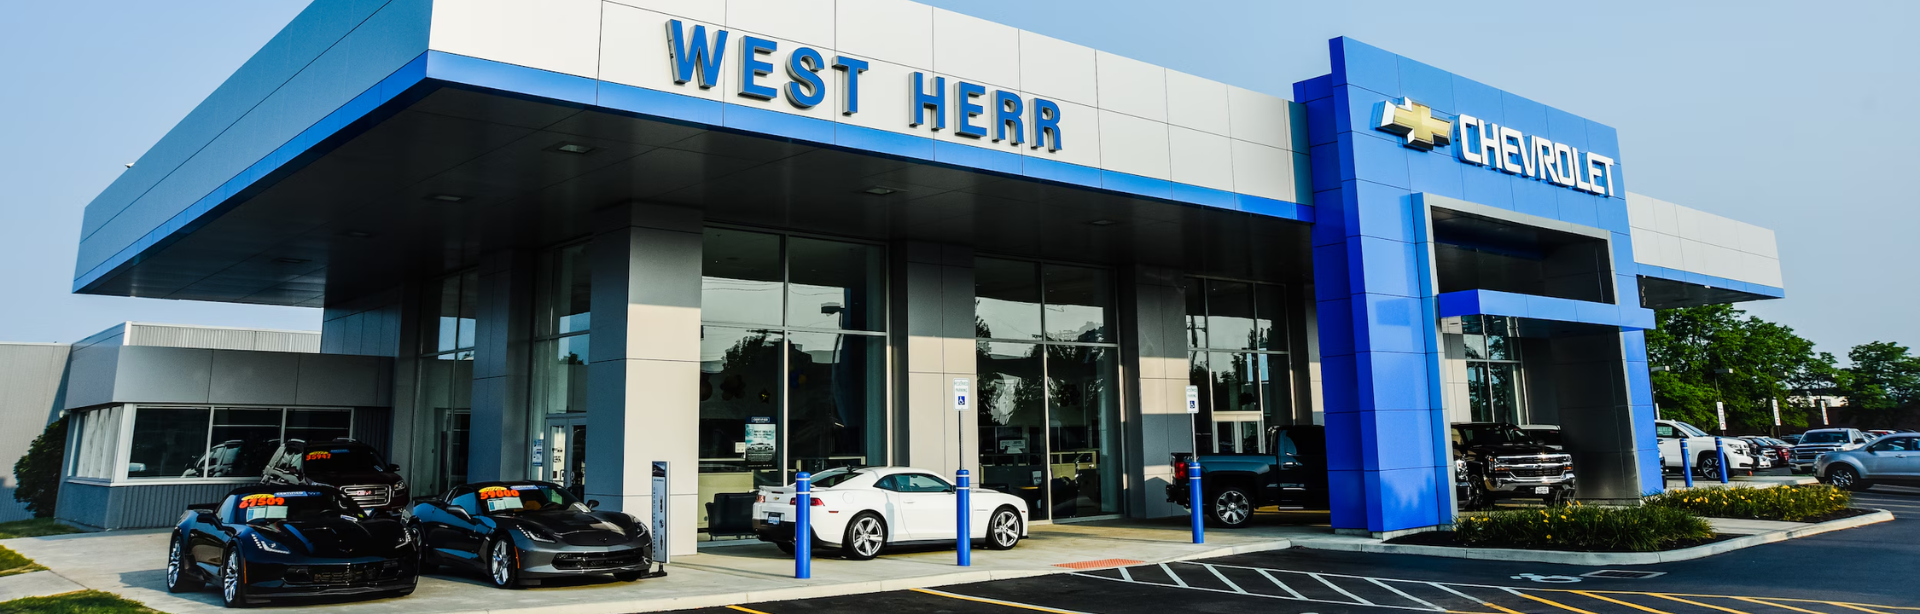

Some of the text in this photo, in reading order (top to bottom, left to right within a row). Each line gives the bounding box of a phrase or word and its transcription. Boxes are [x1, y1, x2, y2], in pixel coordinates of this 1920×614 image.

[666, 19, 1063, 152] WEST HERR
[1457, 113, 1615, 197] CHEVROLET
